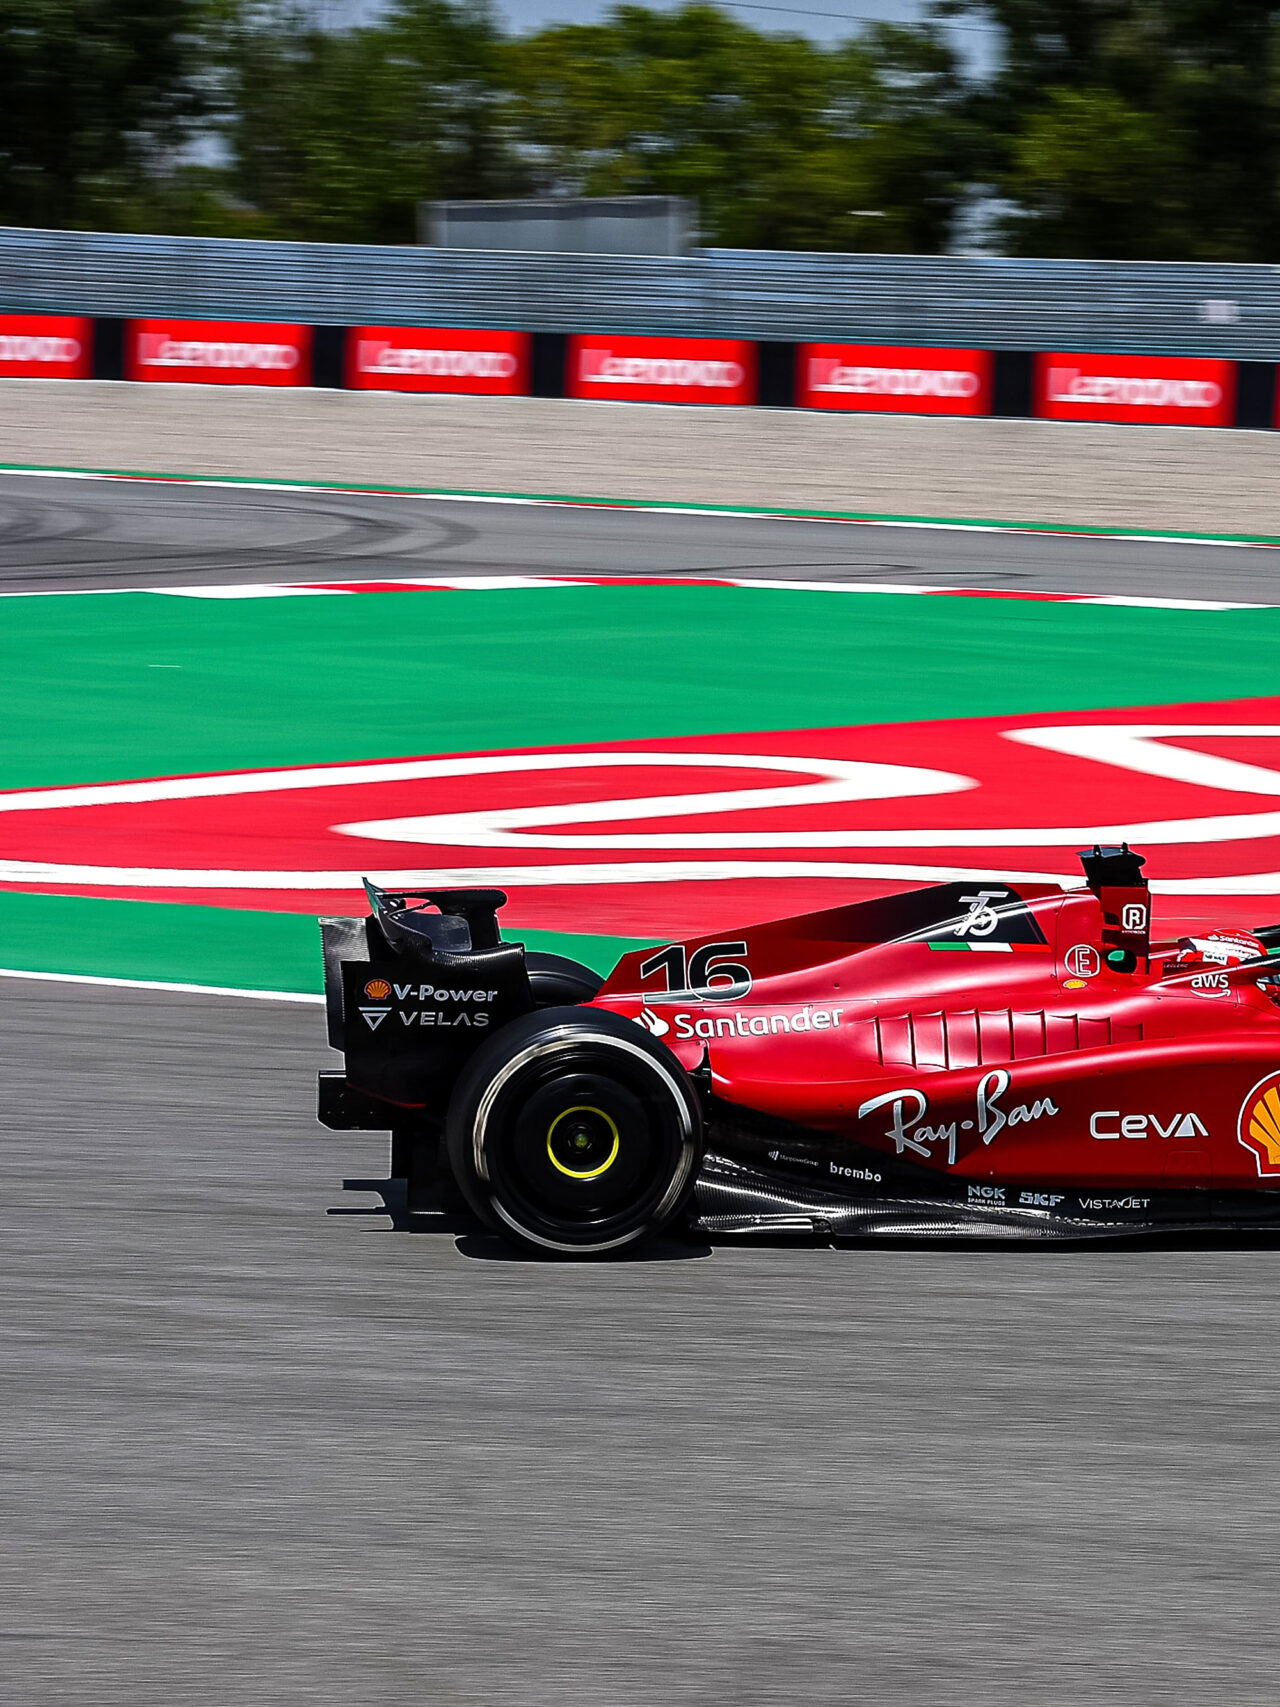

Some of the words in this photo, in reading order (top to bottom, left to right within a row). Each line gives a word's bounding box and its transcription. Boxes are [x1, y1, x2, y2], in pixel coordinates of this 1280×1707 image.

[138, 333, 298, 369] Lenovo
[358, 340, 517, 378] Lenovo
[579, 349, 744, 388] Lenovo
[808, 357, 979, 397] Lenovo
[1047, 367, 1221, 408] Lenovo
[640, 941, 753, 1004] 16
[1191, 974, 1229, 988] aws
[393, 984, 498, 1002] V-Power
[399, 1011, 489, 1027] VELAS
[673, 1006, 844, 1039] Santander
[858, 1069, 1059, 1164] Ray-Ban
[829, 1162, 882, 1182] brembo
[967, 1185, 1006, 1199] NGK
[1019, 1192, 1065, 1206] SKF
